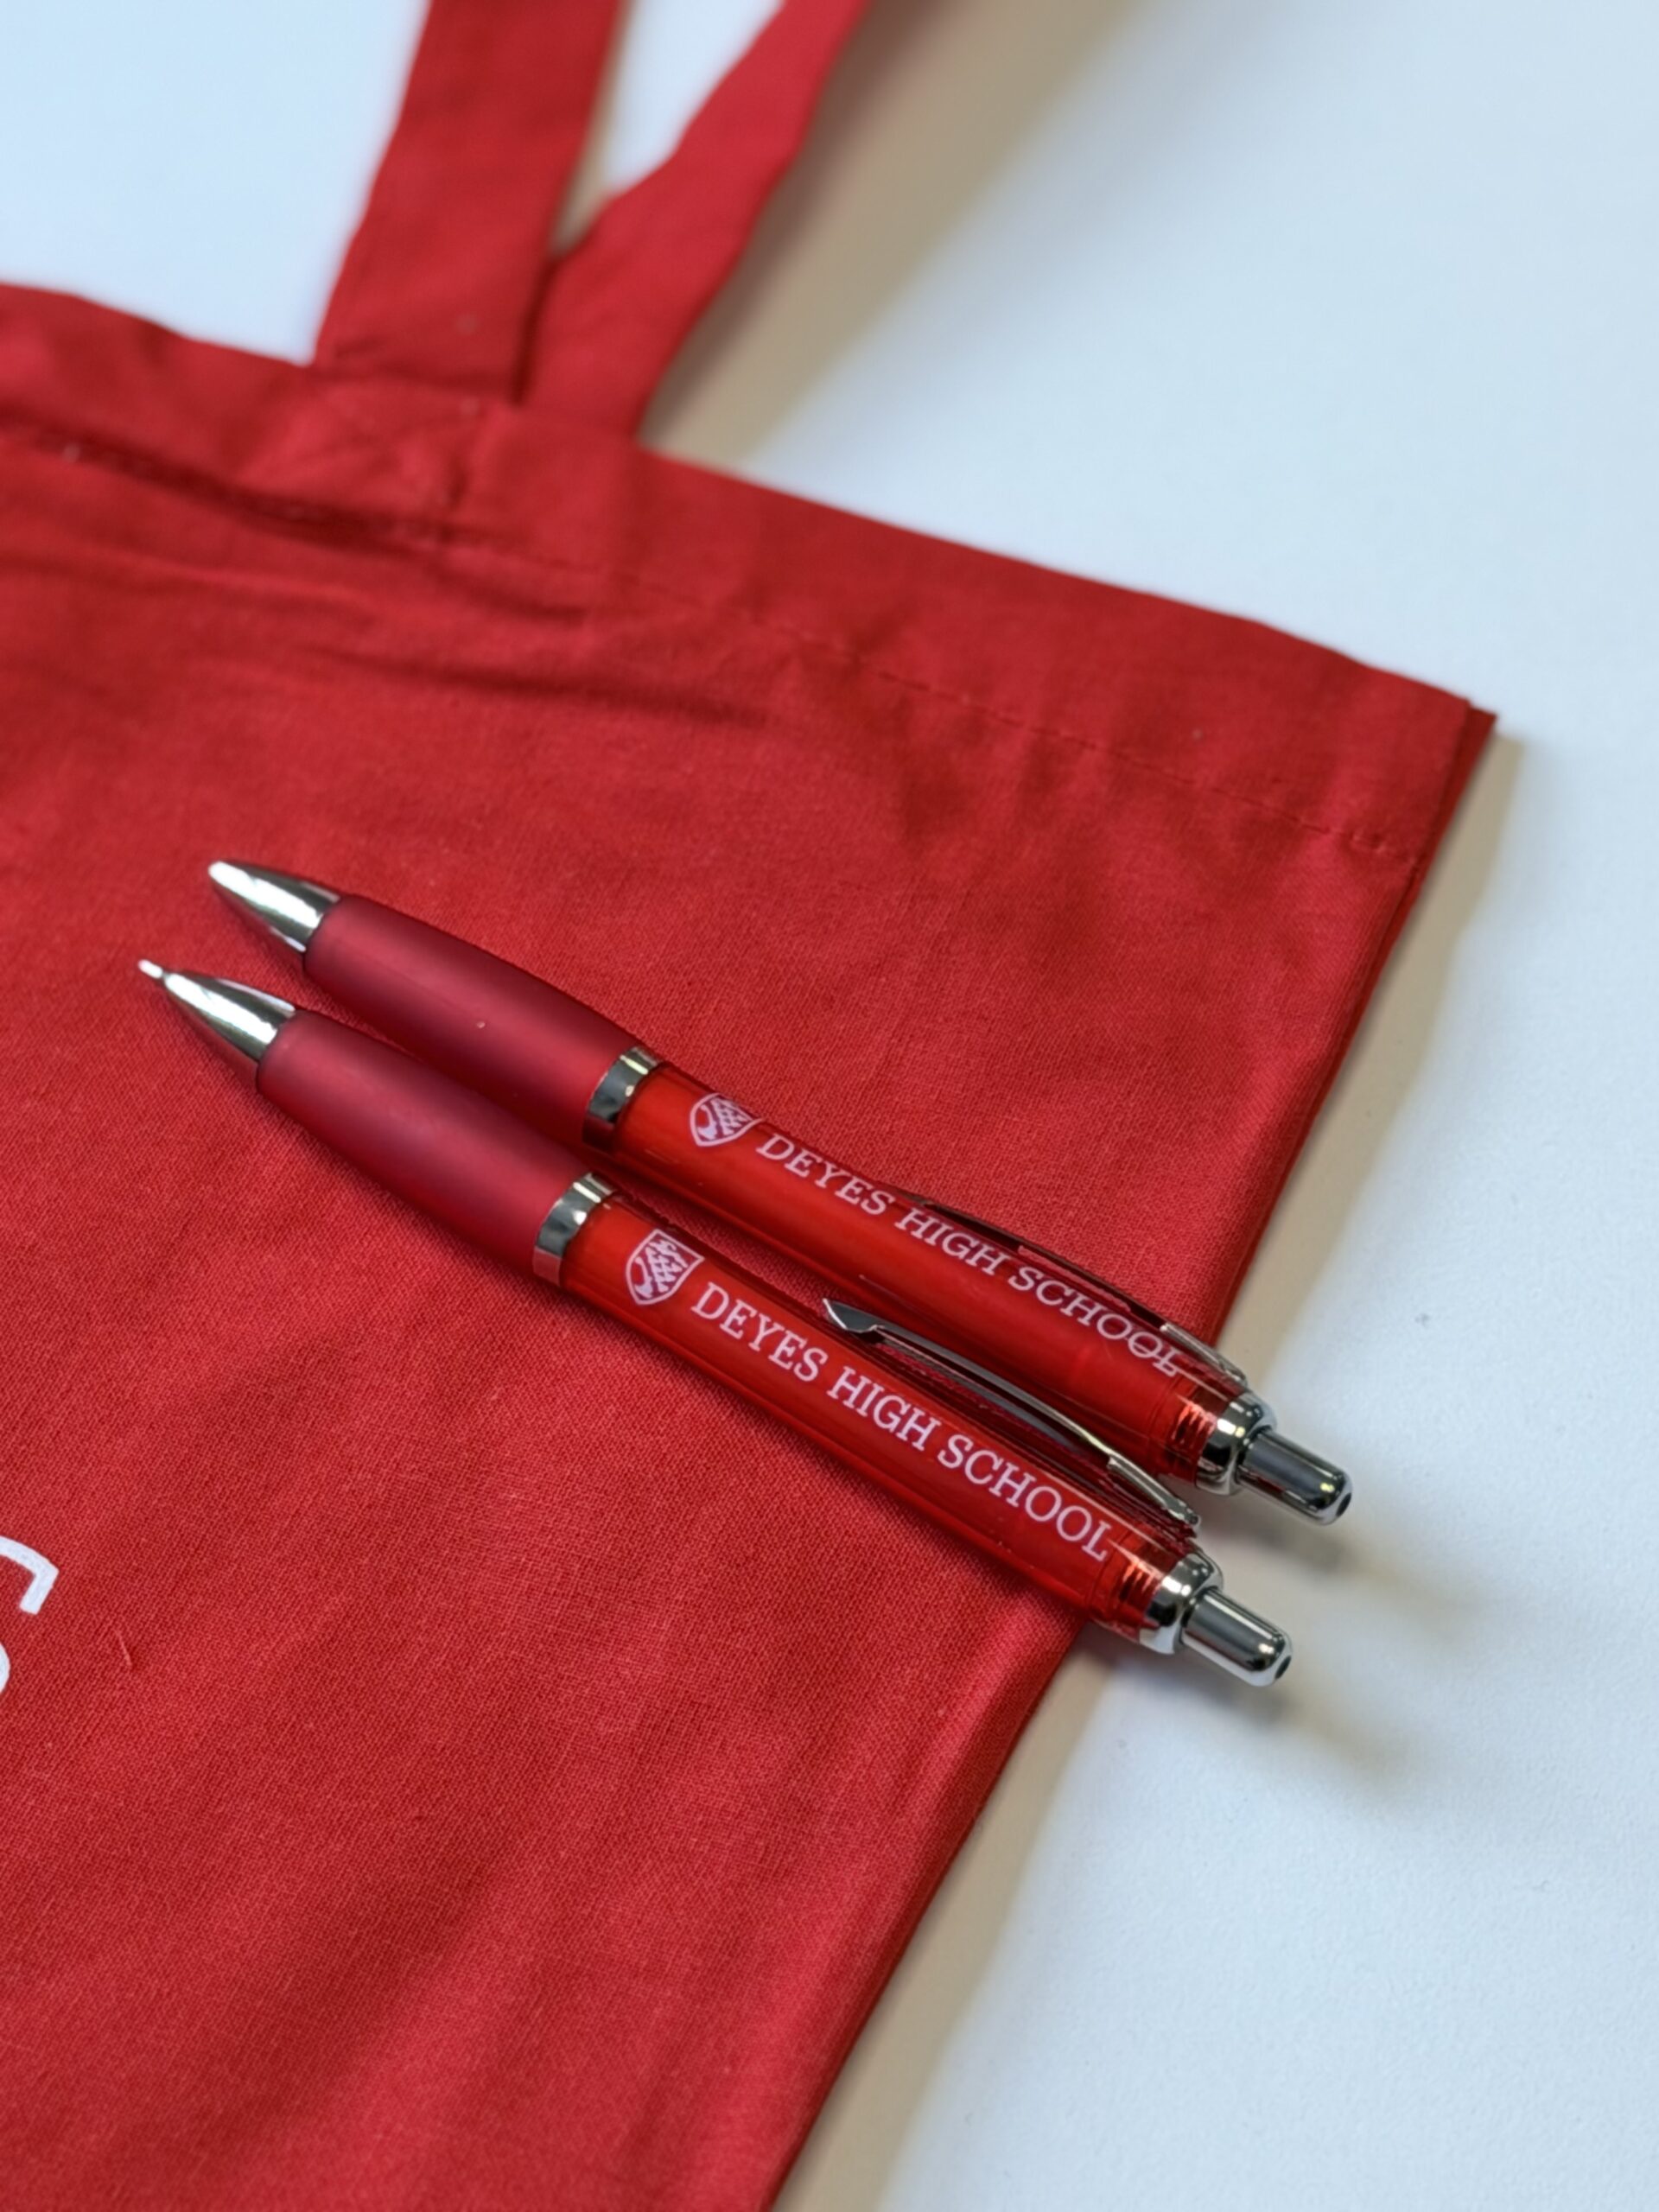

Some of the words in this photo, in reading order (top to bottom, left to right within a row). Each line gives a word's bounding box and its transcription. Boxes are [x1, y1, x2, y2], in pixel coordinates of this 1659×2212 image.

[756, 1132, 896, 1215] DEYES
[895, 1208, 1016, 1276] HIGH
[1007, 1268, 1185, 1379] SCHOOL
[690, 1281, 829, 1382] DEYES
[827, 1365, 942, 1452] HIGH
[938, 1433, 1115, 1561] SCHOOL
